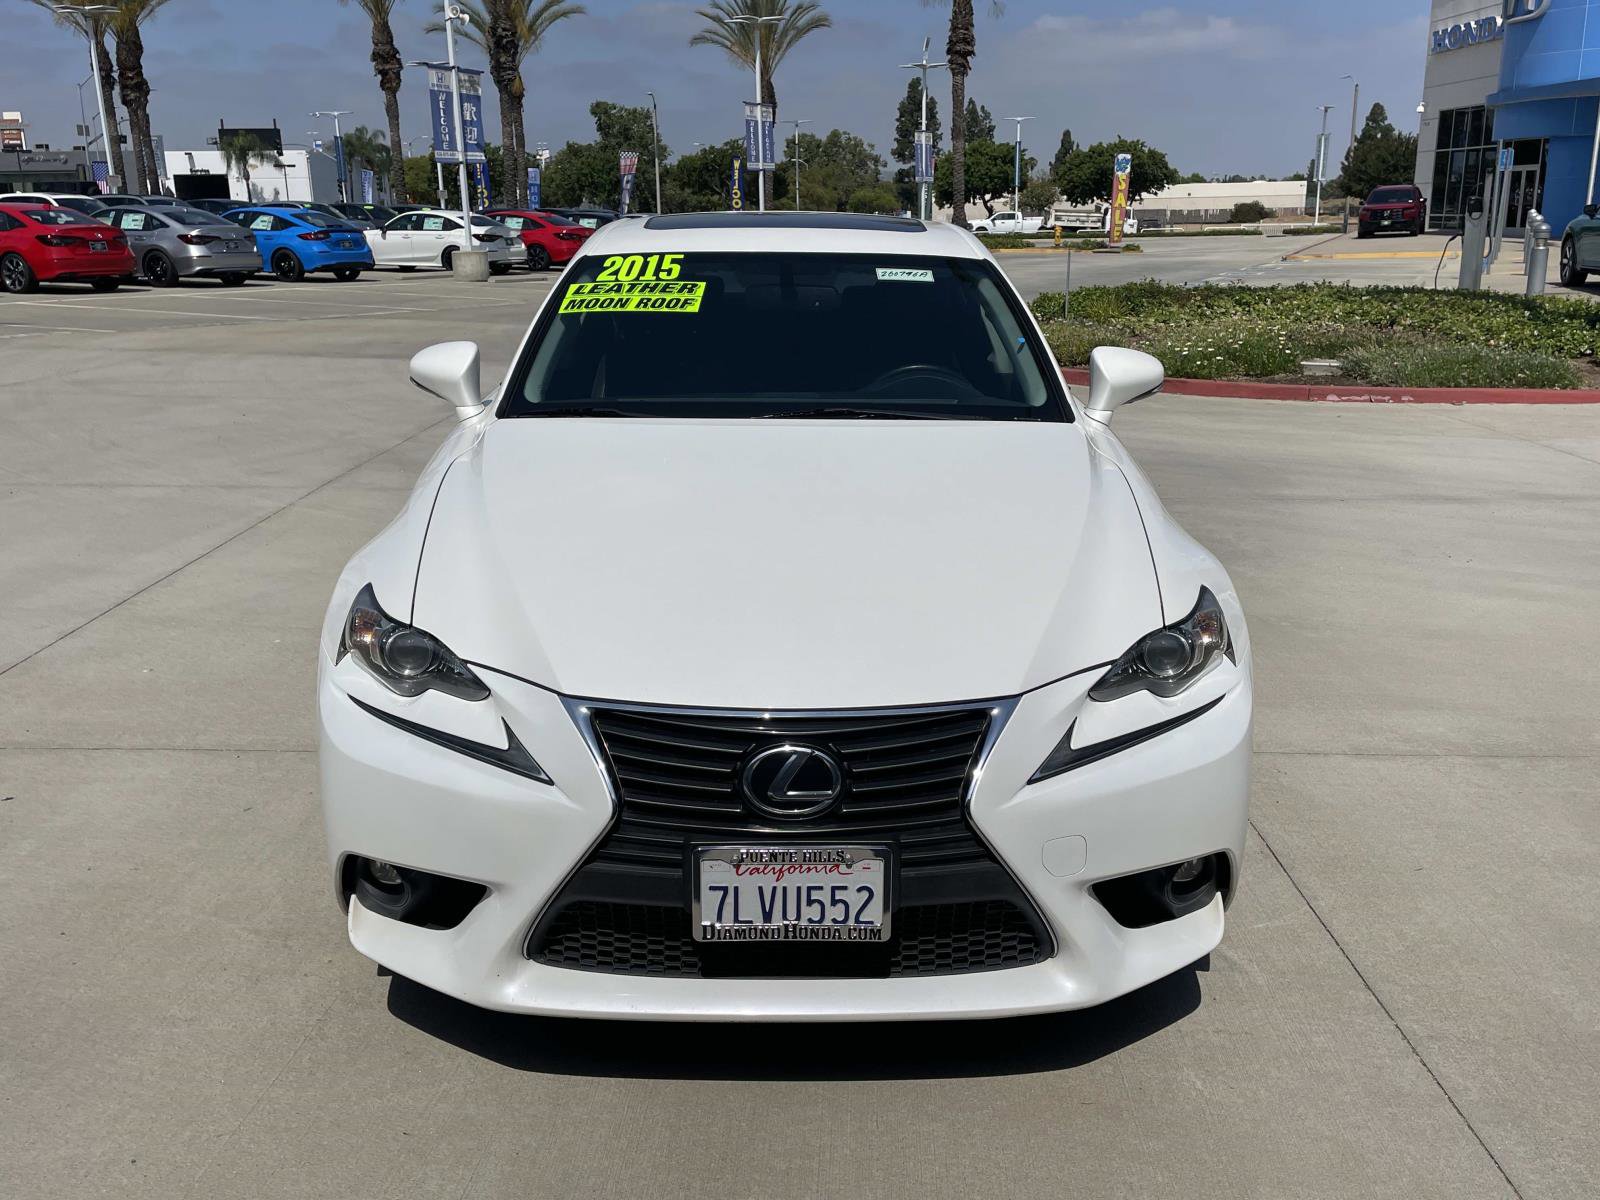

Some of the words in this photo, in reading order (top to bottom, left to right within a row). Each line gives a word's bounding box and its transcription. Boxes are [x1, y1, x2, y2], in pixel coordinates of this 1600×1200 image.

[438, 92, 450, 150] WELCOME
[1113, 174, 1127, 241] SALE
[596, 254, 684, 282] 2015
[572, 282, 701, 296] LEATHER
[563, 297, 633, 311] MOON
[634, 297, 696, 311] ROOF
[738, 850, 798, 863] PUENTE
[802, 850, 846, 863] HILLS
[735, 864, 853, 882] California
[708, 885, 875, 925] 7LVU552
[702, 921, 882, 941] DIAMONDHONDA.COM
